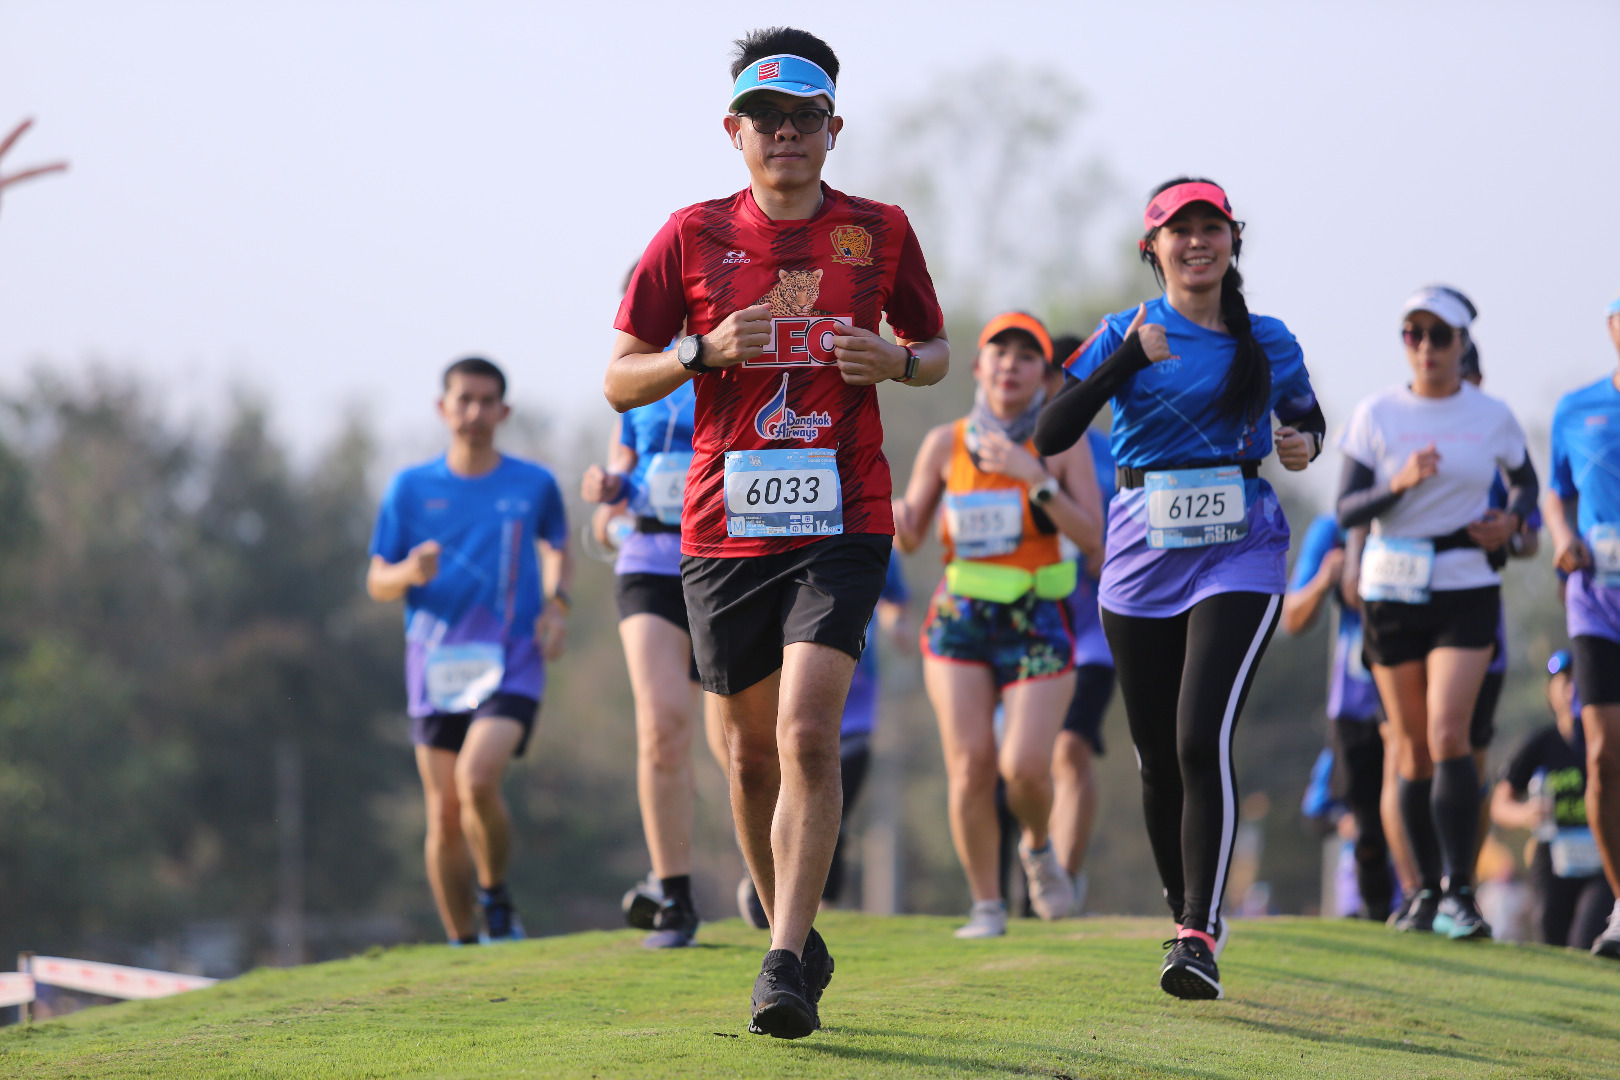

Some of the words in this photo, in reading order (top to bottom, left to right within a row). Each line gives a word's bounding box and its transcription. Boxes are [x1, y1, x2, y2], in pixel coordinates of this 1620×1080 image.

[786, 410, 831, 429] Bangkok
[775, 422, 818, 441] Airways
[746, 476, 820, 506] 6033
[1169, 491, 1226, 519] 6125
[732, 520, 744, 532] M
[815, 519, 829, 534] 16
